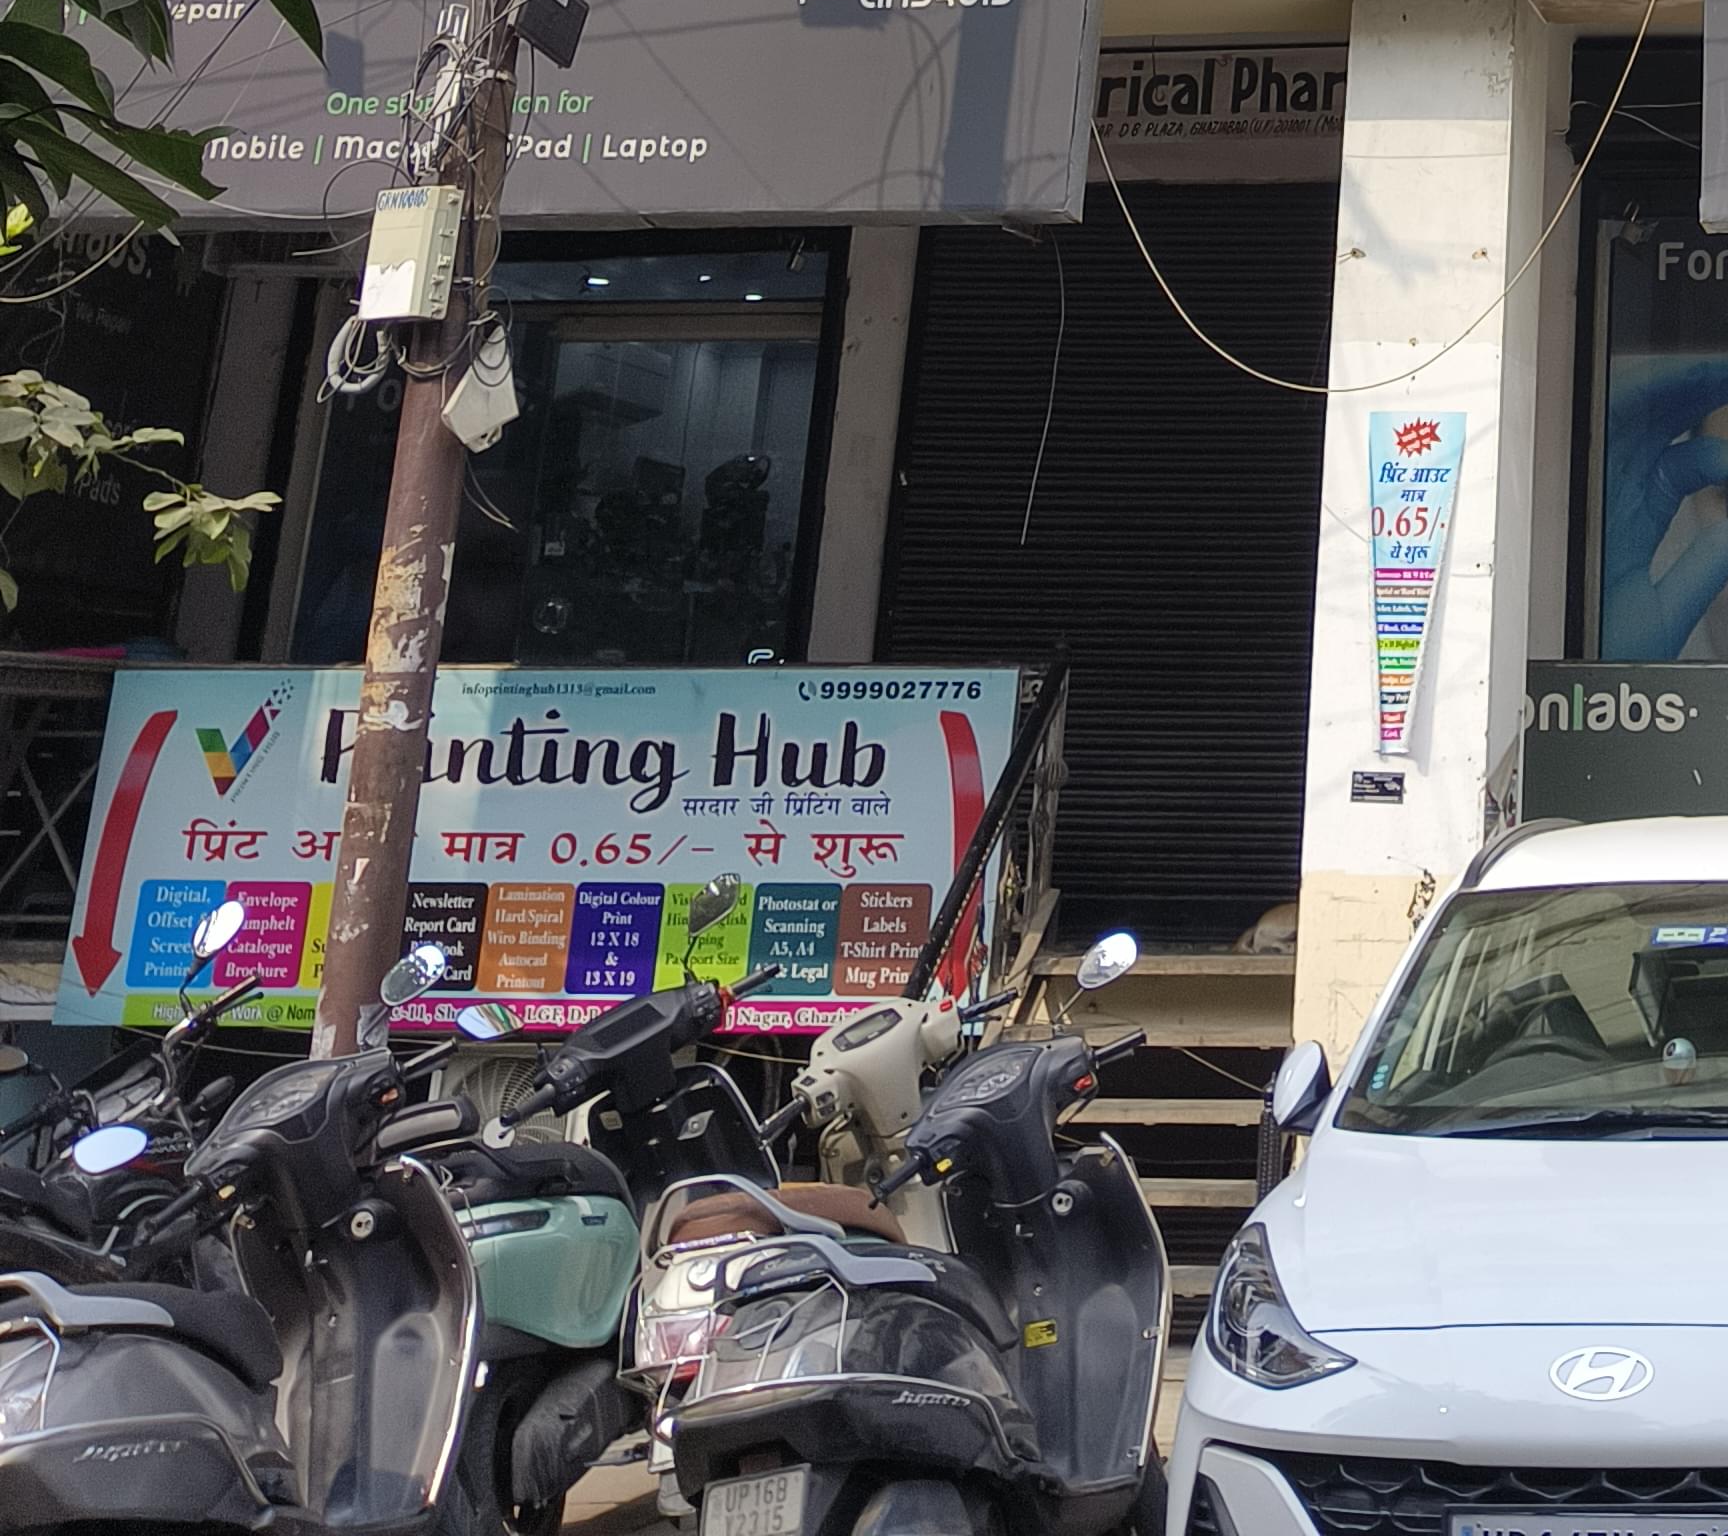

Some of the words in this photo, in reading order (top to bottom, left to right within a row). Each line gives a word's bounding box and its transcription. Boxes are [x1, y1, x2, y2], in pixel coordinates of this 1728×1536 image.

[327, 92, 377, 116] One
[558, 90, 594, 114] for
[602, 134, 708, 163] Laptop
[820, 681, 982, 701] 9999027776
[1523, 683, 1698, 732] nlabs.
[320, 709, 689, 813] Pnting
[712, 711, 887, 788] Hub
[681, 796, 740, 816] सरदार
[182, 819, 267, 864] प्रिंट
[441, 831, 524, 865] मात्र
[744, 819, 787, 866] से
[811, 832, 904, 878] शुरू
[412, 892, 475, 909] Newsletter
[498, 887, 565, 903] Lamination
[579, 891, 618, 908] Digital
[620, 891, 661, 906] Colour
[758, 895, 820, 911] Photostat
[860, 892, 913, 909] Stickers
[147, 913, 193, 929] Offset
[404, 917, 445, 937] Report
[446, 916, 476, 933] Card
[602, 911, 632, 925] Print
[864, 916, 907, 933] Labels
[764, 919, 826, 937] Scanning
[226, 938, 293, 959] Catalogue
[519, 931, 567, 949] Binding
[841, 941, 888, 958] T-Shirt
[225, 961, 288, 978] Brochure
[792, 962, 828, 980] Legal
[845, 967, 877, 984] Mug
[737, 1008, 792, 1028] Nagar,
